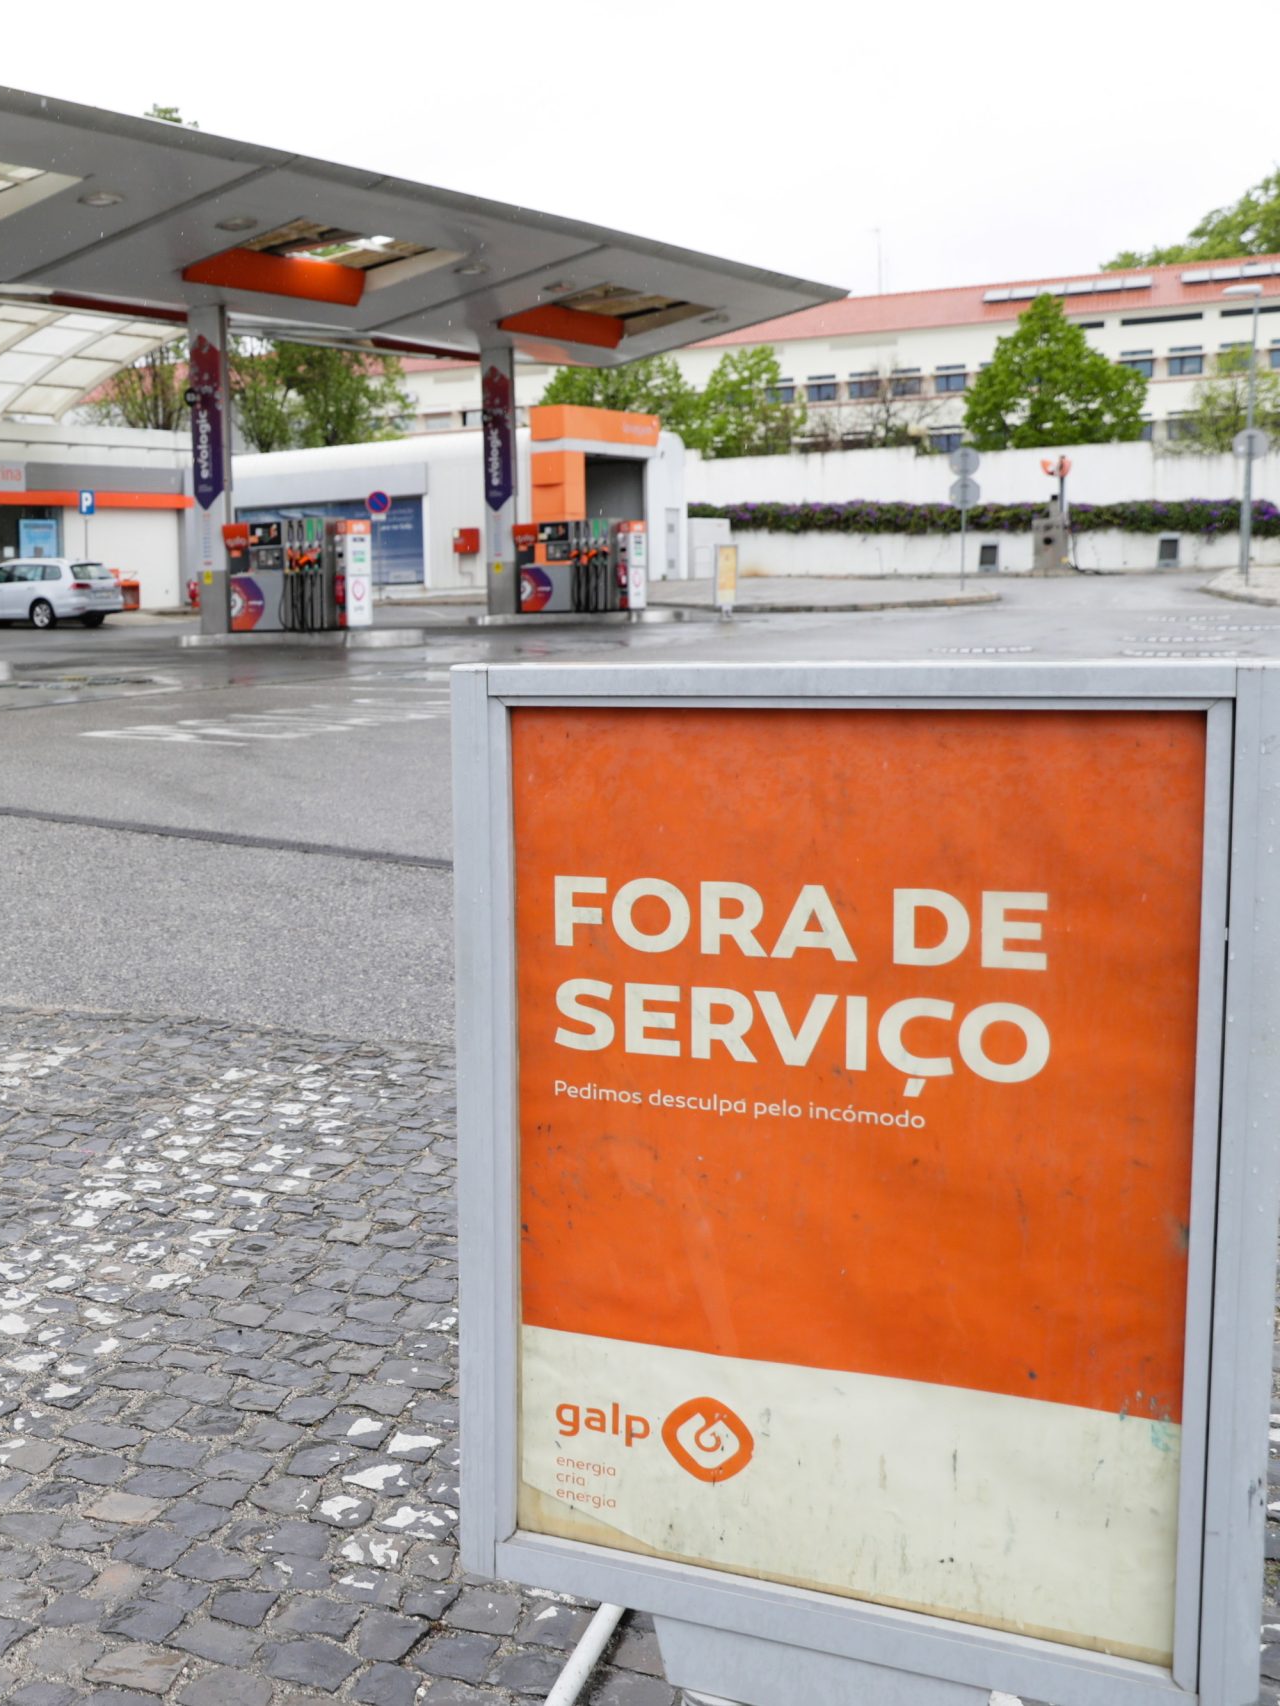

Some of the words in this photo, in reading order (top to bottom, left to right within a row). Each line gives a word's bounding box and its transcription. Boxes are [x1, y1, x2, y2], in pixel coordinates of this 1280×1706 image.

[196, 409, 211, 479] evologic
[82, 492, 92, 511] P
[554, 874, 858, 962] FORA
[893, 888, 1048, 971] DE
[554, 978, 1051, 1098] SERVIÇO
[554, 1080, 642, 1106] Pedimos
[648, 1090, 747, 1117] desculpa
[753, 1099, 802, 1125] pelo
[808, 1102, 926, 1130] incómodo
[555, 1402, 650, 1448] galp
[556, 1456, 616, 1477] energia
[556, 1471, 585, 1487] cria
[556, 1487, 616, 1509] energia
